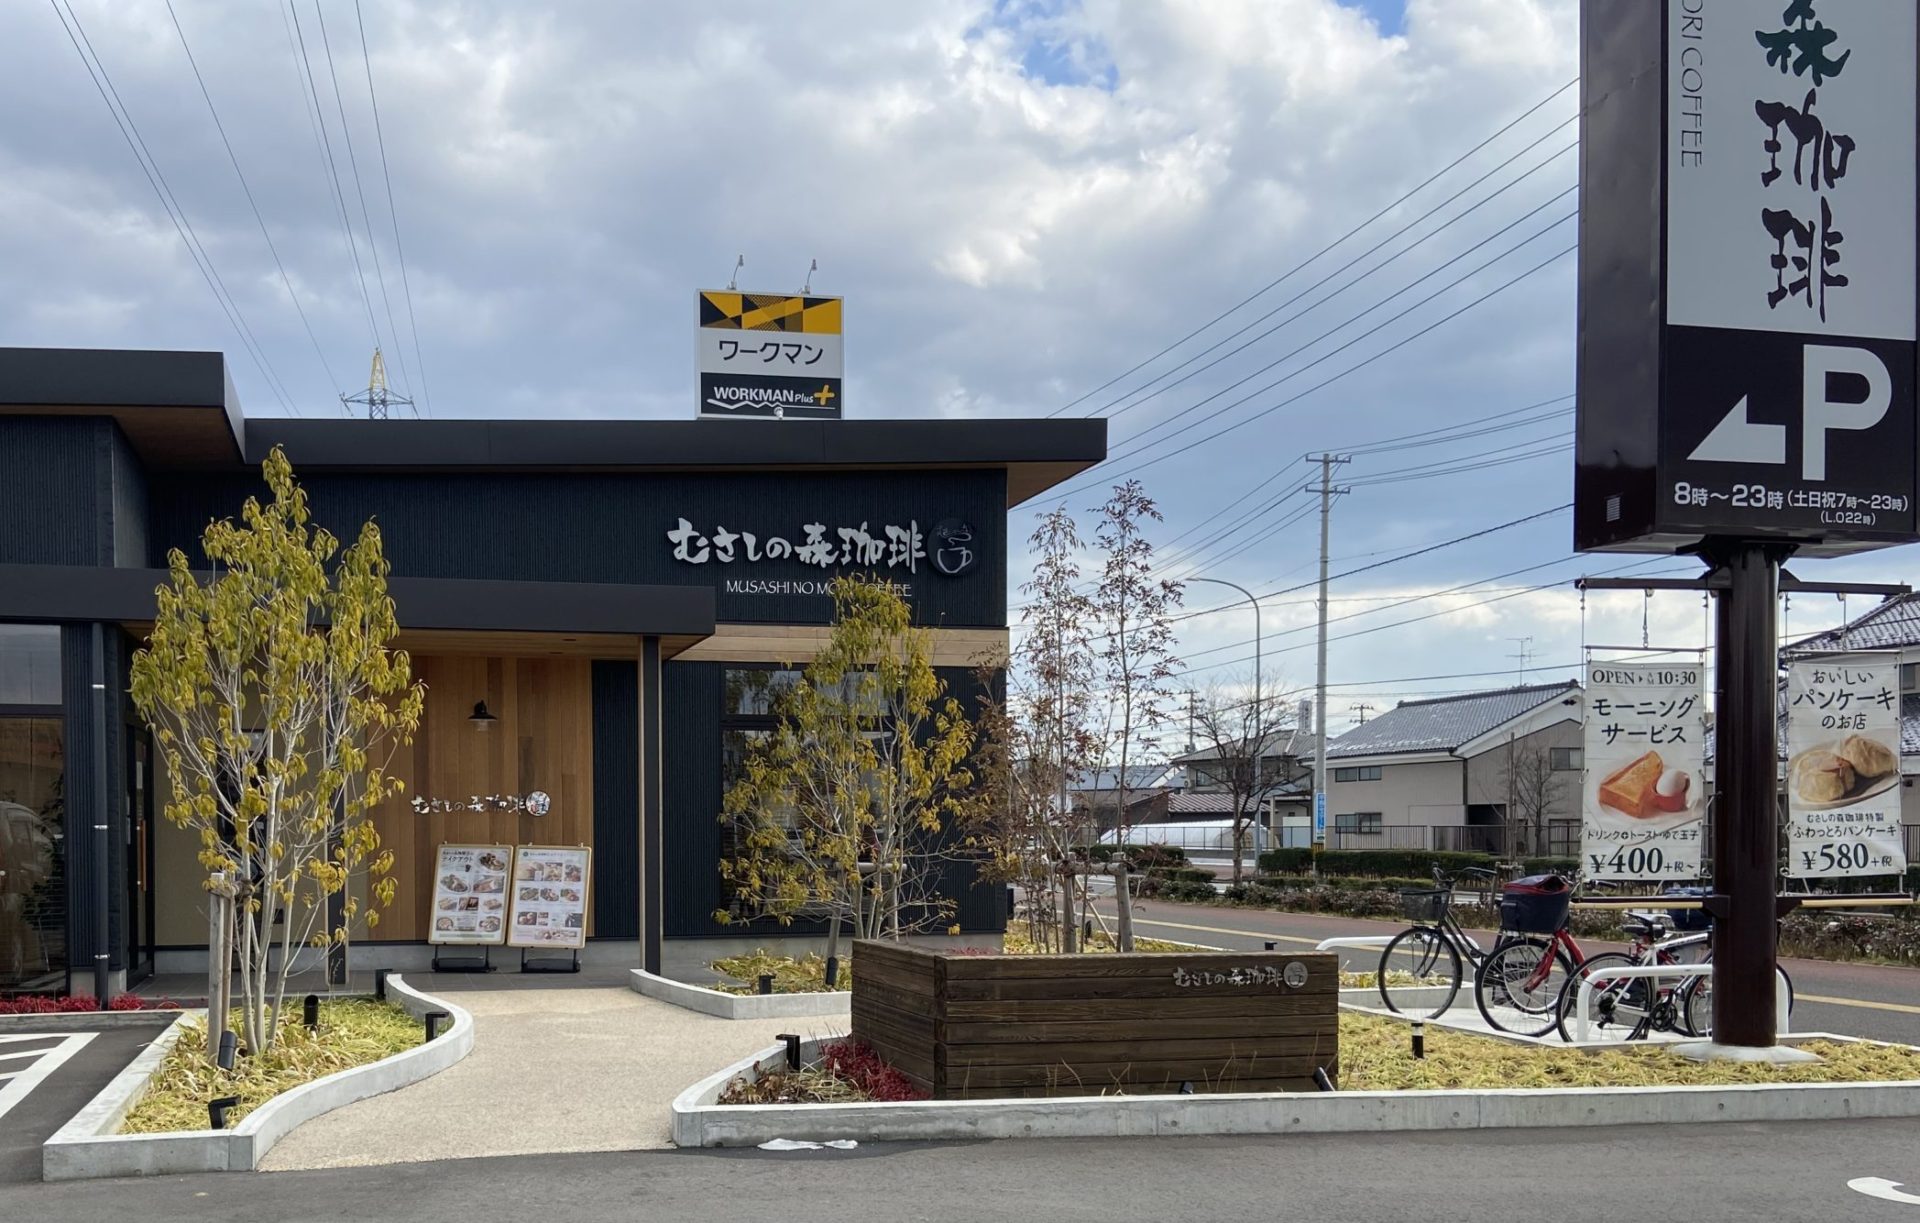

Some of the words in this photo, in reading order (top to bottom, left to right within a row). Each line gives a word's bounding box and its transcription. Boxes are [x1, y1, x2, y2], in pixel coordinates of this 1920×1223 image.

[1682, 47, 1703, 168] COFFEE
[1755, 0, 1856, 323] 森珈琲
[719, 340, 823, 365] ワークマン
[713, 386, 794, 402] WORKMAN
[794, 394, 814, 403] Plus
[1802, 344, 1892, 481] P
[667, 518, 926, 574] むさしの森珈琲
[726, 580, 789, 594] MUSASHI
[793, 582, 814, 595] NO
[1592, 670, 1635, 685] OPEN
[1657, 671, 1696, 686] 10:30
[1813, 669, 1874, 685] おいしい
[1592, 694, 1699, 719] モーニング
[1793, 687, 1895, 711] パンケーキ
[1822, 712, 1867, 730] のお店
[1601, 723, 1687, 745] サービス
[1793, 825, 1897, 838] ふわっとろパンケーキ
